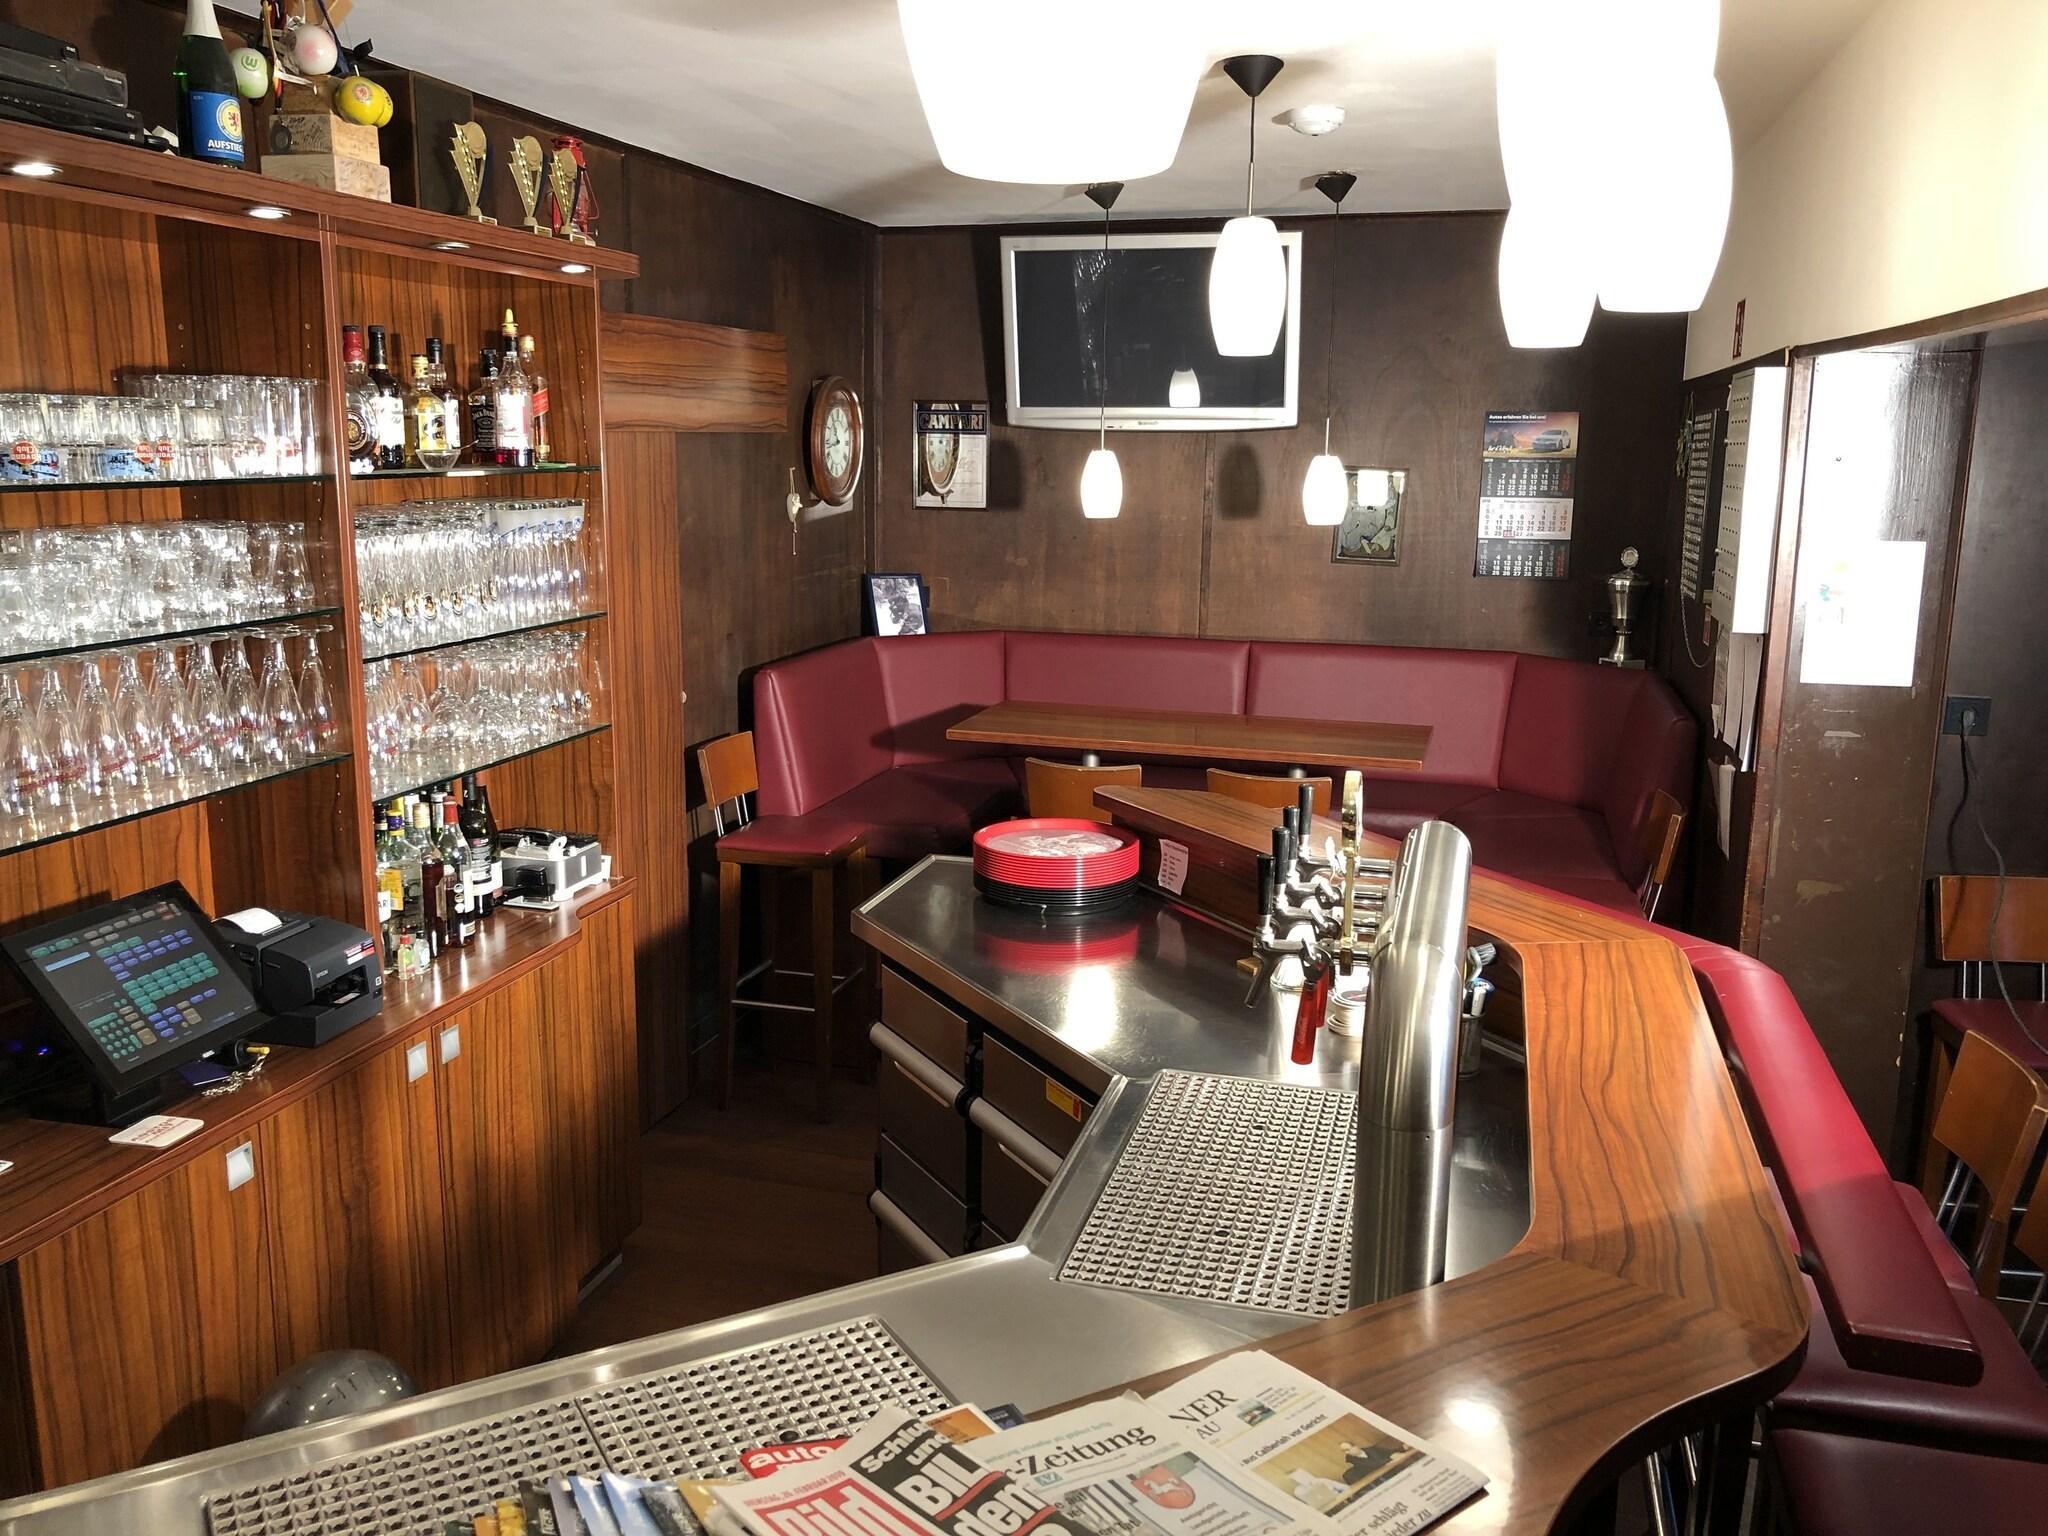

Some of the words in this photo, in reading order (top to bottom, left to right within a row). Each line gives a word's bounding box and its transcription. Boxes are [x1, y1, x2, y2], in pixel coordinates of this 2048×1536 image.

[920, 414, 984, 430] CAMPARI
[1196, 1420, 1222, 1440] AU
[748, 1446, 834, 1470] auto
[860, 1422, 925, 1474] Schlu
[1004, 1426, 1156, 1482] r-Zeitung
[894, 1452, 991, 1516] BIL
[1368, 1502, 1408, 1530] schlägt
